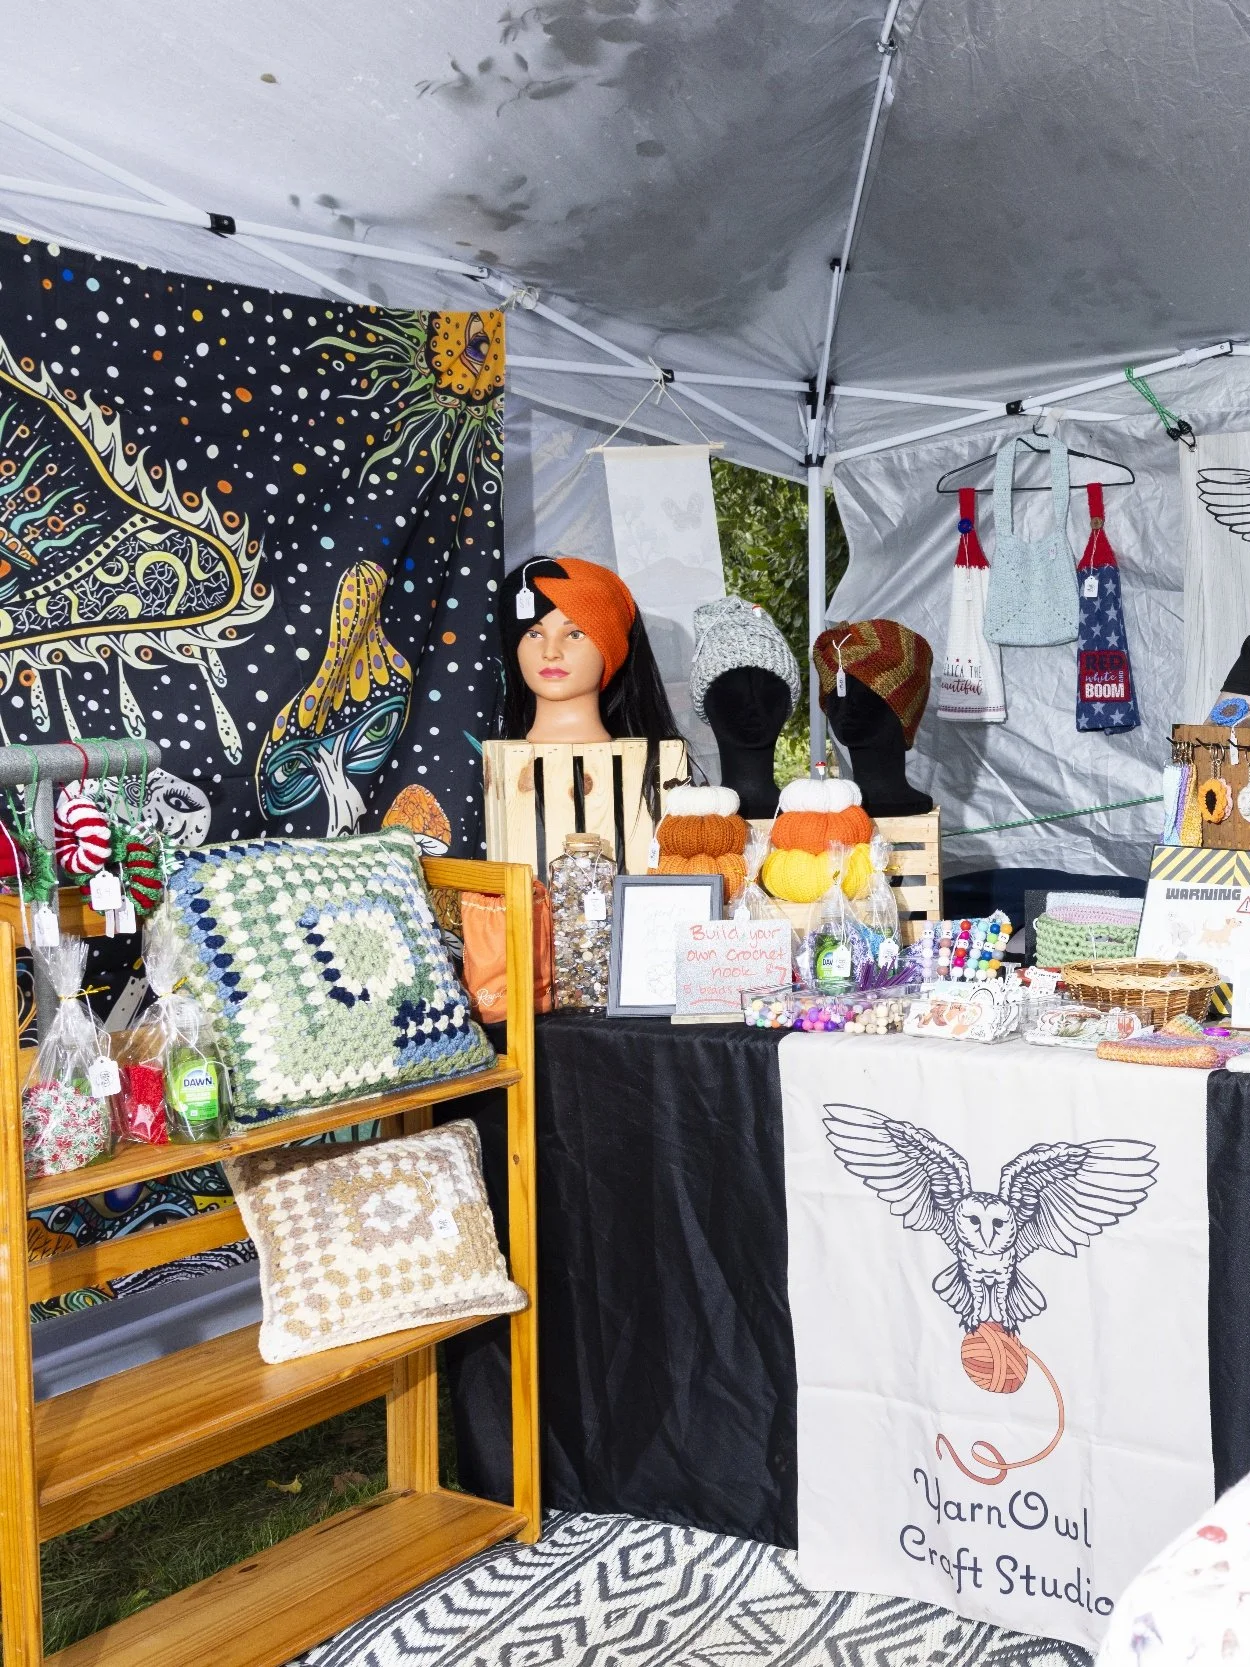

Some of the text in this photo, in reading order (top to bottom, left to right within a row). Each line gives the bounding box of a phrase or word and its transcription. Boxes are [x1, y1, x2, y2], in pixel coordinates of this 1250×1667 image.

[1086, 654, 1123, 671] RED
[969, 665, 982, 678] THE
[1085, 671, 1117, 683] white
[1085, 683, 1125, 698] BOOM
[1166, 887, 1241, 901] WARNING
[689, 924, 781, 949] Build your
[686, 949, 717, 962] own
[822, 957, 833, 966] DAW
[683, 982, 692, 995] 5
[183, 1076, 213, 1087] DAWN
[913, 1467, 1092, 1549] YarnOwl
[899, 1523, 1115, 1617] Craft Studio
